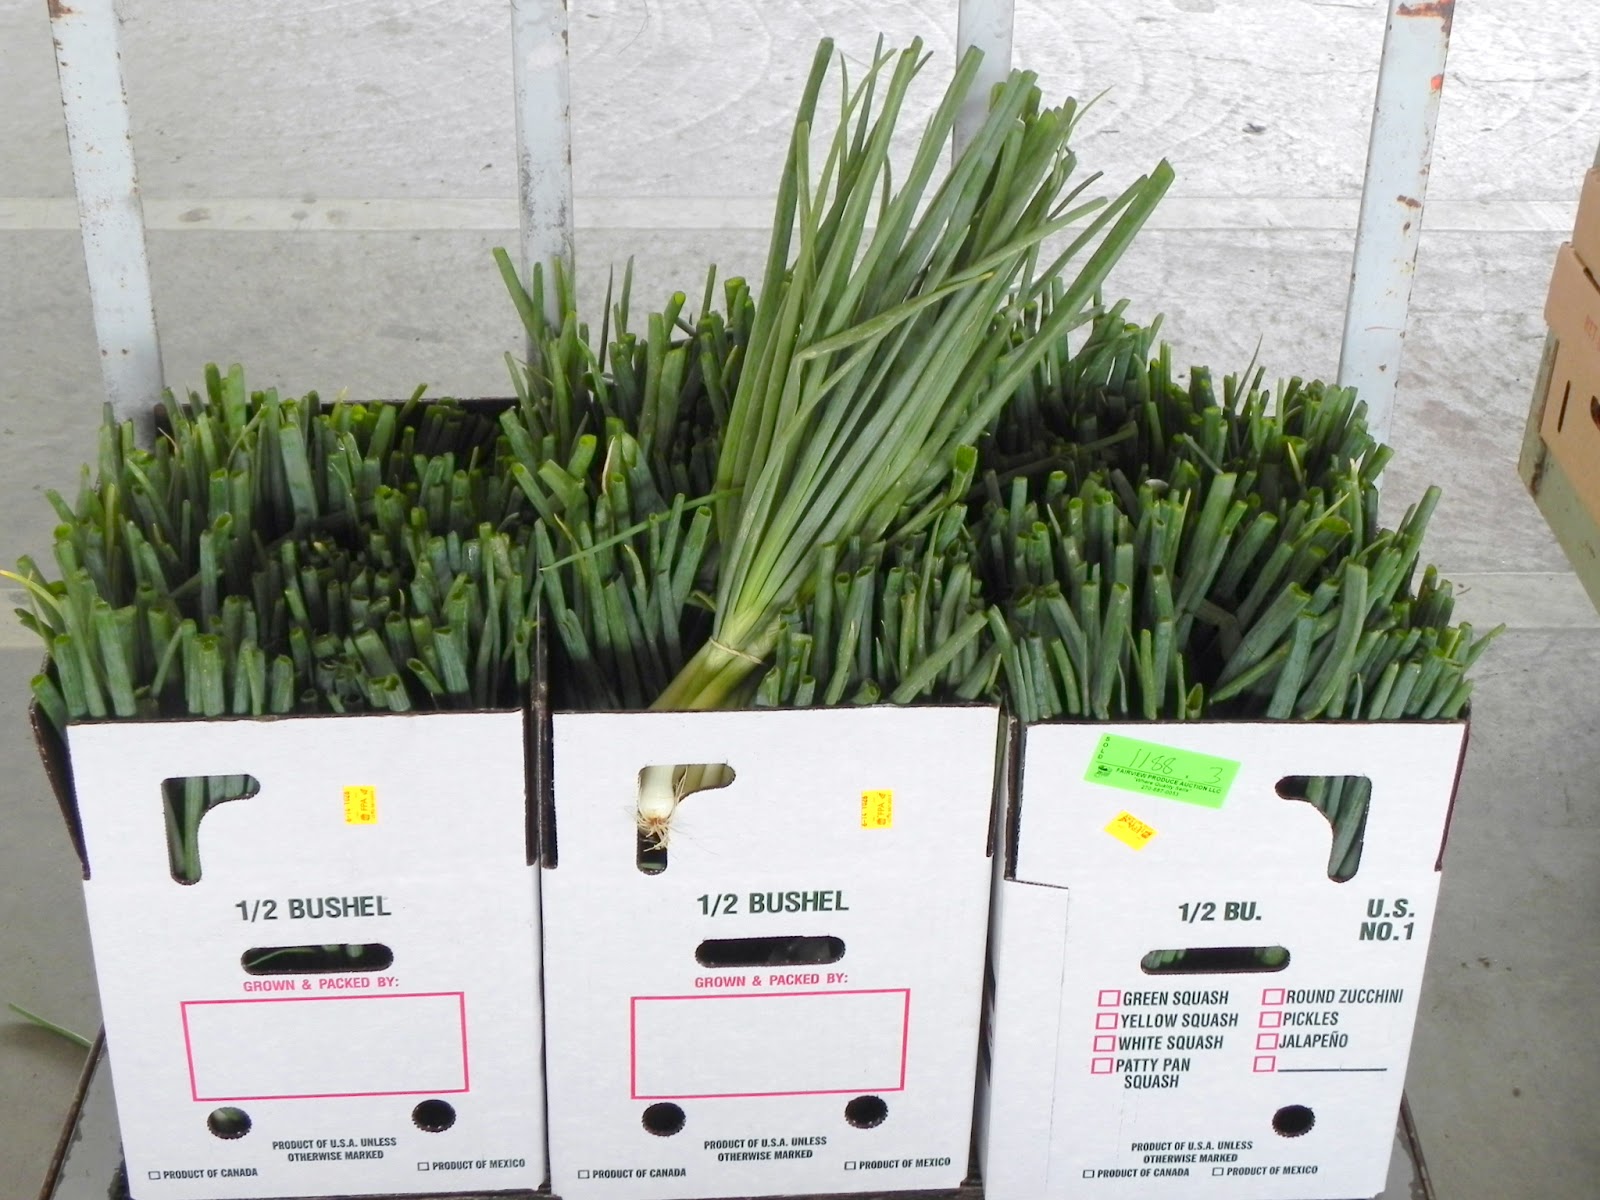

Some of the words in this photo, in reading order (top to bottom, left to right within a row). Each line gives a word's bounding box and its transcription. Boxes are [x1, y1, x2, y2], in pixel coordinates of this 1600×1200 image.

[1116, 767, 1147, 779] FAIRVIEW
[1149, 774, 1178, 786] PRODUCE
[1179, 781, 1208, 791] AUCTION
[235, 899, 278, 922] 1/2
[288, 896, 392, 919] BUSHEL
[697, 893, 738, 917] 1/2
[749, 890, 849, 913] BUSHEL
[1367, 898, 1414, 918] U.S.
[1178, 902, 1216, 923] 1/2
[1224, 902, 1261, 921] BU.
[1359, 922, 1414, 941] NO.1
[243, 980, 295, 992] GROWN
[302, 979, 312, 990] &
[319, 977, 370, 989] PACKED
[378, 977, 398, 987] BY:
[695, 976, 746, 988] GROWN
[752, 976, 761, 986] &
[770, 974, 819, 985] PACKED
[827, 973, 847, 983] BY:
[1123, 991, 1168, 1006] GREEN
[1173, 990, 1229, 1006] SQUASH
[1286, 989, 1335, 1004] ROUND
[1339, 989, 1403, 1003] ZUCCHINI
[1121, 1014, 1178, 1028] YELLOW
[1182, 1013, 1238, 1028] SQUASH
[1283, 1011, 1339, 1026] PICKLES
[1119, 1036, 1163, 1050] WHITE
[1167, 1035, 1224, 1050] SQUASH
[1278, 1031, 1348, 1048] JALAPEÑO
[1116, 1058, 1159, 1072] PATTY
[1163, 1058, 1190, 1071] PAN
[1124, 1074, 1179, 1089] SQUASH
[272, 1140, 314, 1150] PRODUCT
[316, 1139, 327, 1148] OF
[330, 1139, 358, 1148] U.S.A.
[361, 1137, 397, 1147] UNLESS
[704, 1139, 745, 1150] PRODUCT
[748, 1139, 759, 1148] OF
[761, 1138, 788, 1147] U.S.A.
[791, 1136, 827, 1146] UNLESS
[1131, 1142, 1172, 1151] PRODUCT
[1174, 1142, 1186, 1150] OF
[1188, 1141, 1214, 1150] U.S.A.
[1218, 1141, 1253, 1150] UNLESS
[288, 1152, 342, 1162] OTHERWISE
[345, 1150, 384, 1160] MARKED
[718, 1151, 771, 1162] OTHERWISE
[774, 1150, 813, 1160] MARKED
[859, 1160, 900, 1170] PRODUCT
[902, 1159, 914, 1168] OF
[915, 1157, 950, 1167] MEXICO
[1143, 1154, 1197, 1164] OTHERWISE
[1199, 1154, 1238, 1162] MARKED
[433, 1161, 473, 1170] PRODUCT
[476, 1160, 487, 1169] OF
[490, 1159, 525, 1168] MEXICO
[1227, 1167, 1267, 1176] PRODUCT
[1269, 1166, 1281, 1175] OF
[1283, 1166, 1318, 1174] MEXICO
[163, 1170, 204, 1179] PRODUCT
[207, 1169, 218, 1178] OF
[221, 1168, 258, 1177] CANADA
[593, 1169, 633, 1178] PRODUCT
[636, 1169, 647, 1178] OF
[650, 1168, 686, 1178] CANADA
[1097, 1169, 1138, 1178] PRODUCT
[1140, 1168, 1151, 1177] OF
[1153, 1168, 1189, 1177] CANADA
